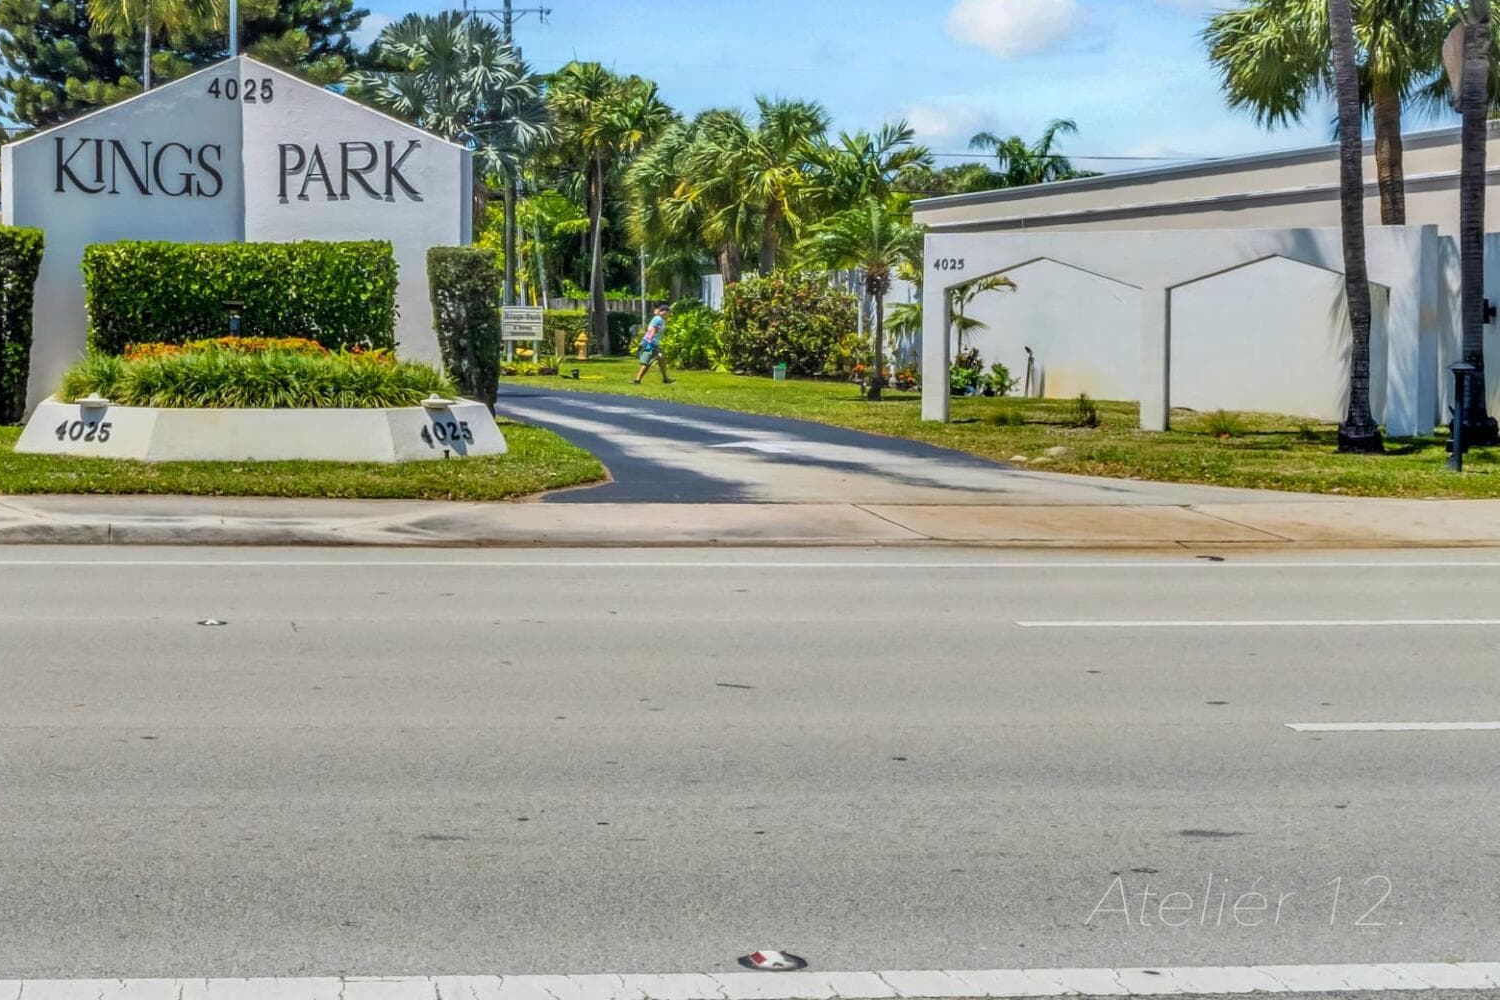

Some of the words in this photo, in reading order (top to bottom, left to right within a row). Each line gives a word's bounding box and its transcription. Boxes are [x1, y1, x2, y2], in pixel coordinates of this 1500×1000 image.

[207, 77, 274, 101] 4025
[54, 136, 224, 198] KINGS
[277, 140, 421, 201] PARK
[933, 258, 965, 271] 4025
[55, 420, 112, 443] 4025
[421, 421, 473, 447] 4025
